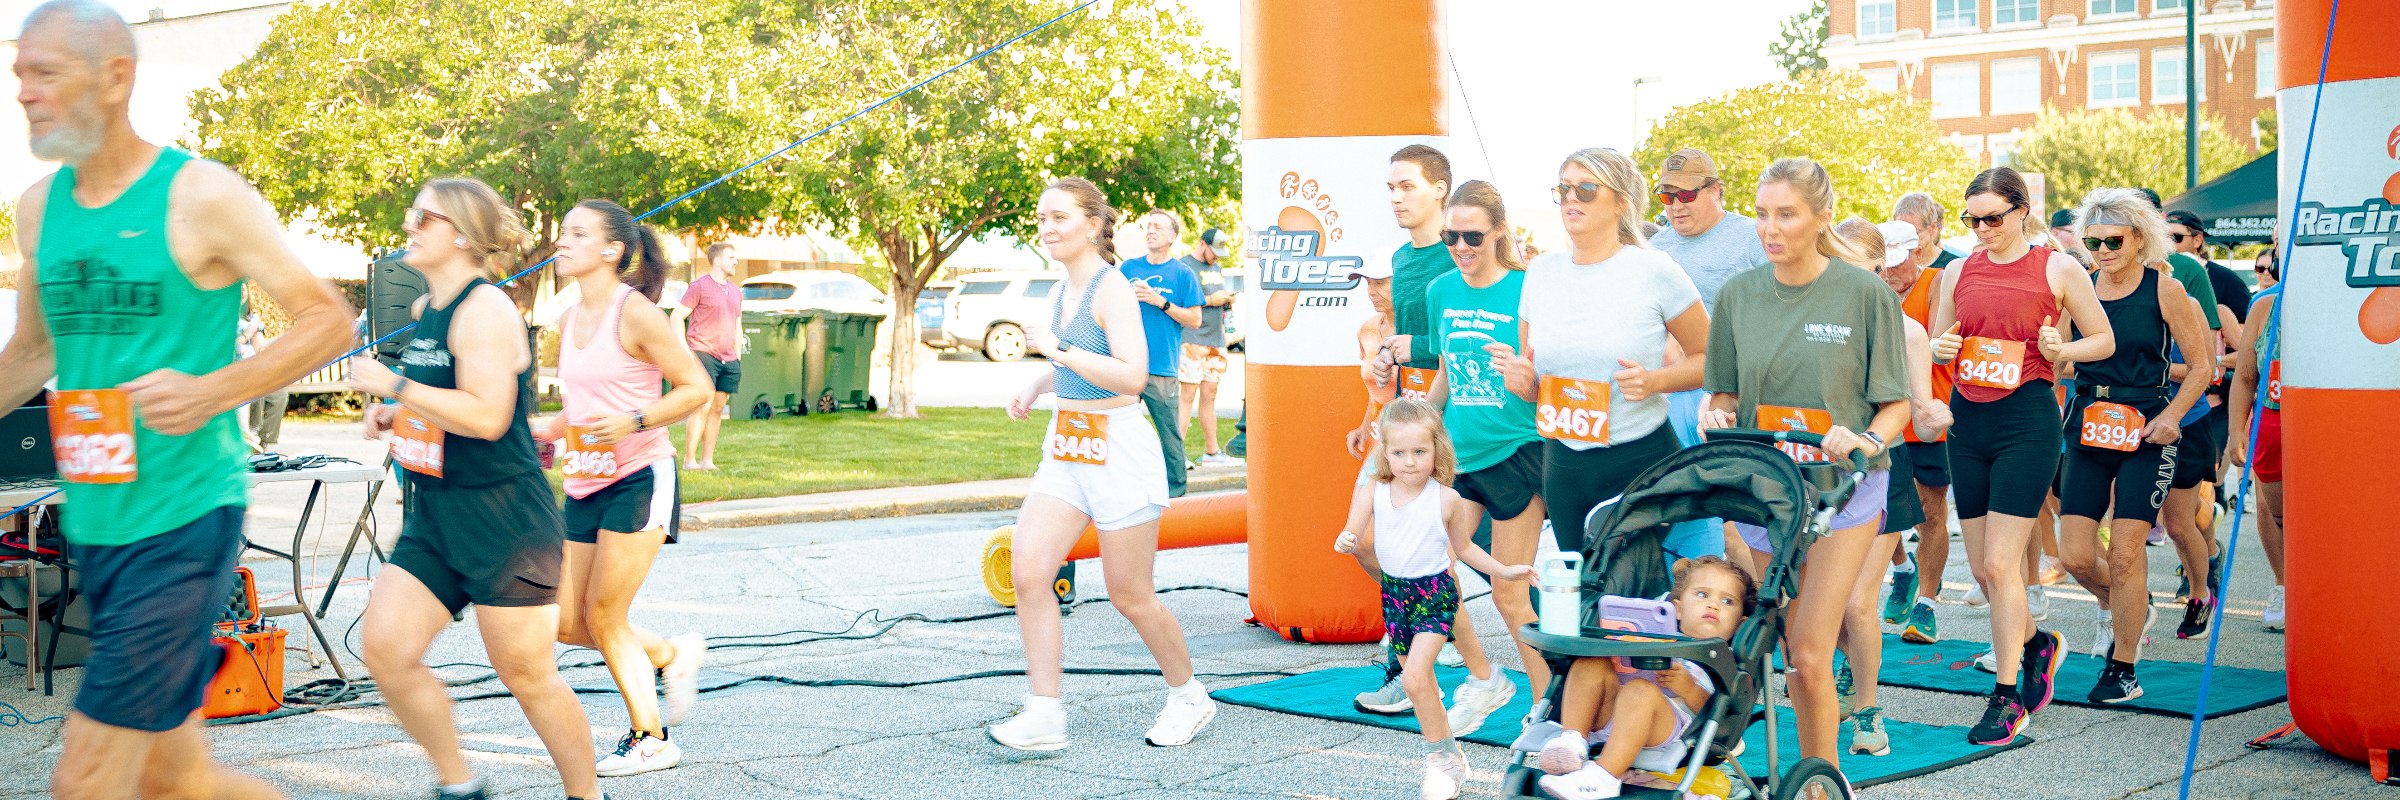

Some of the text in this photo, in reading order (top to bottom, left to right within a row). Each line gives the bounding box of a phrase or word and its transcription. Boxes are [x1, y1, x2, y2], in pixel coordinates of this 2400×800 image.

[1260, 253, 1357, 284] Toes
[1300, 296, 1348, 307] .com
[1960, 359, 2020, 385] 3420
[1537, 404, 1608, 439] 3467
[2083, 421, 2141, 447] 3394
[1053, 433, 1107, 461] 3449
[562, 450, 618, 476] 3466
